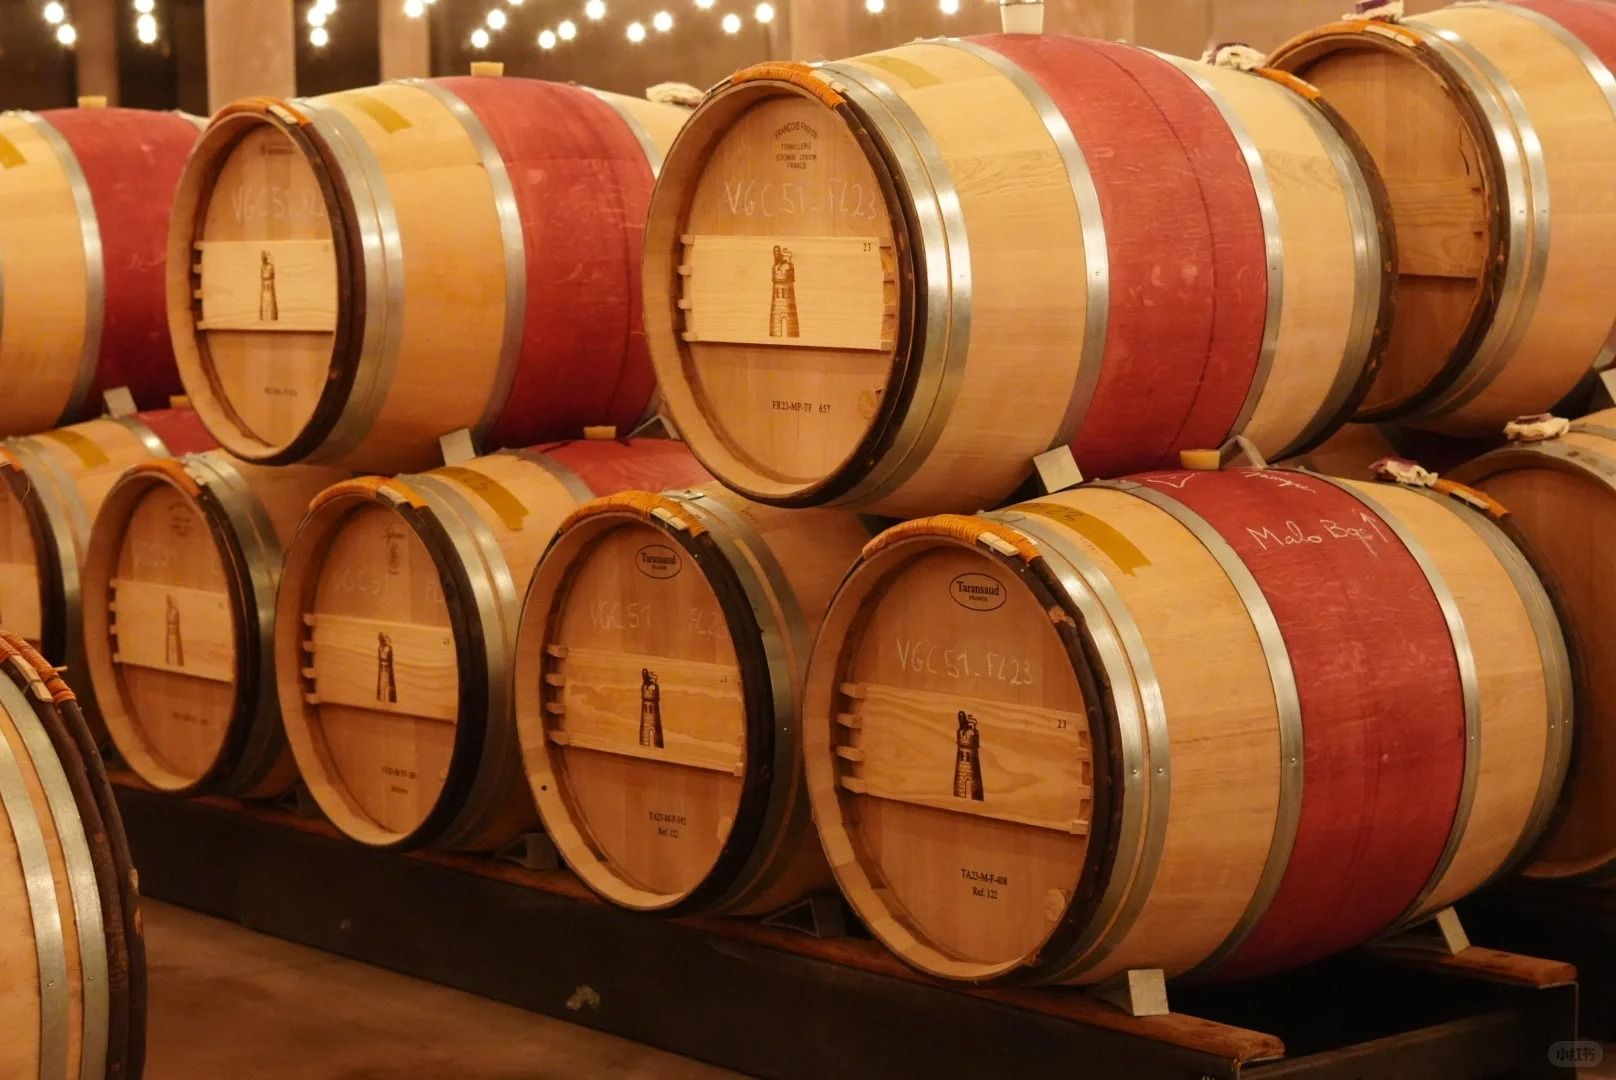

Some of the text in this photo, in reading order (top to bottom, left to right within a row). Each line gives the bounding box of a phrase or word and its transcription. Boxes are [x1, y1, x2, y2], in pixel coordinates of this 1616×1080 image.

[863, 242, 872, 252] 23
[1246, 520, 1322, 551] Malo
[956, 580, 1000, 597] Taransaud
[1057, 719, 1067, 729] 23
[972, 886, 999, 900] Ref. 122
